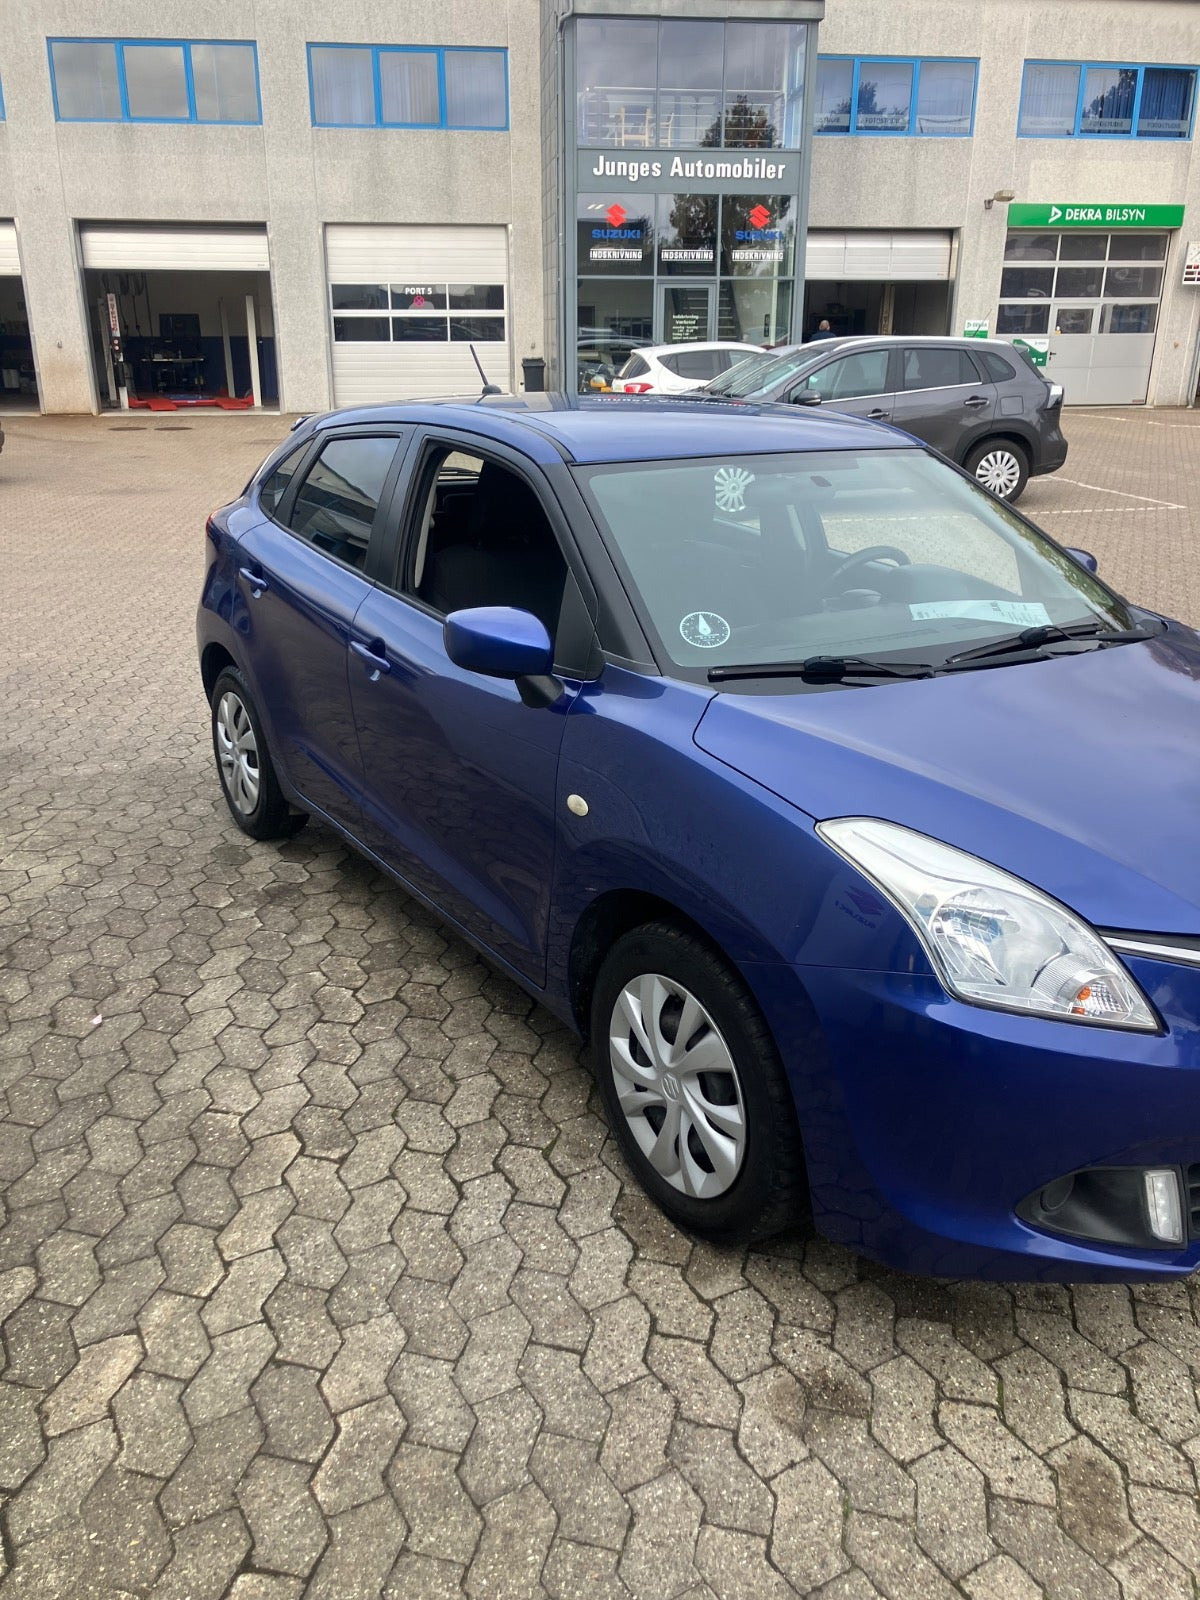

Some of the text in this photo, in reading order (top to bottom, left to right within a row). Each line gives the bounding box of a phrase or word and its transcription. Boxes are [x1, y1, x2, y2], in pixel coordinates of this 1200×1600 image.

[593, 155, 786, 182] Junges Automobiler
[1065, 208, 1146, 221] DEKRA BILSYN
[592, 229, 640, 239] SUZUKI
[735, 230, 783, 240] SUZUKI
[590, 250, 642, 260] INDSKRIVNING
[661, 250, 713, 260] INDSKRIVNING
[732, 250, 783, 260] INDSKRIVNING
[405, 287, 432, 295] PORT 5
